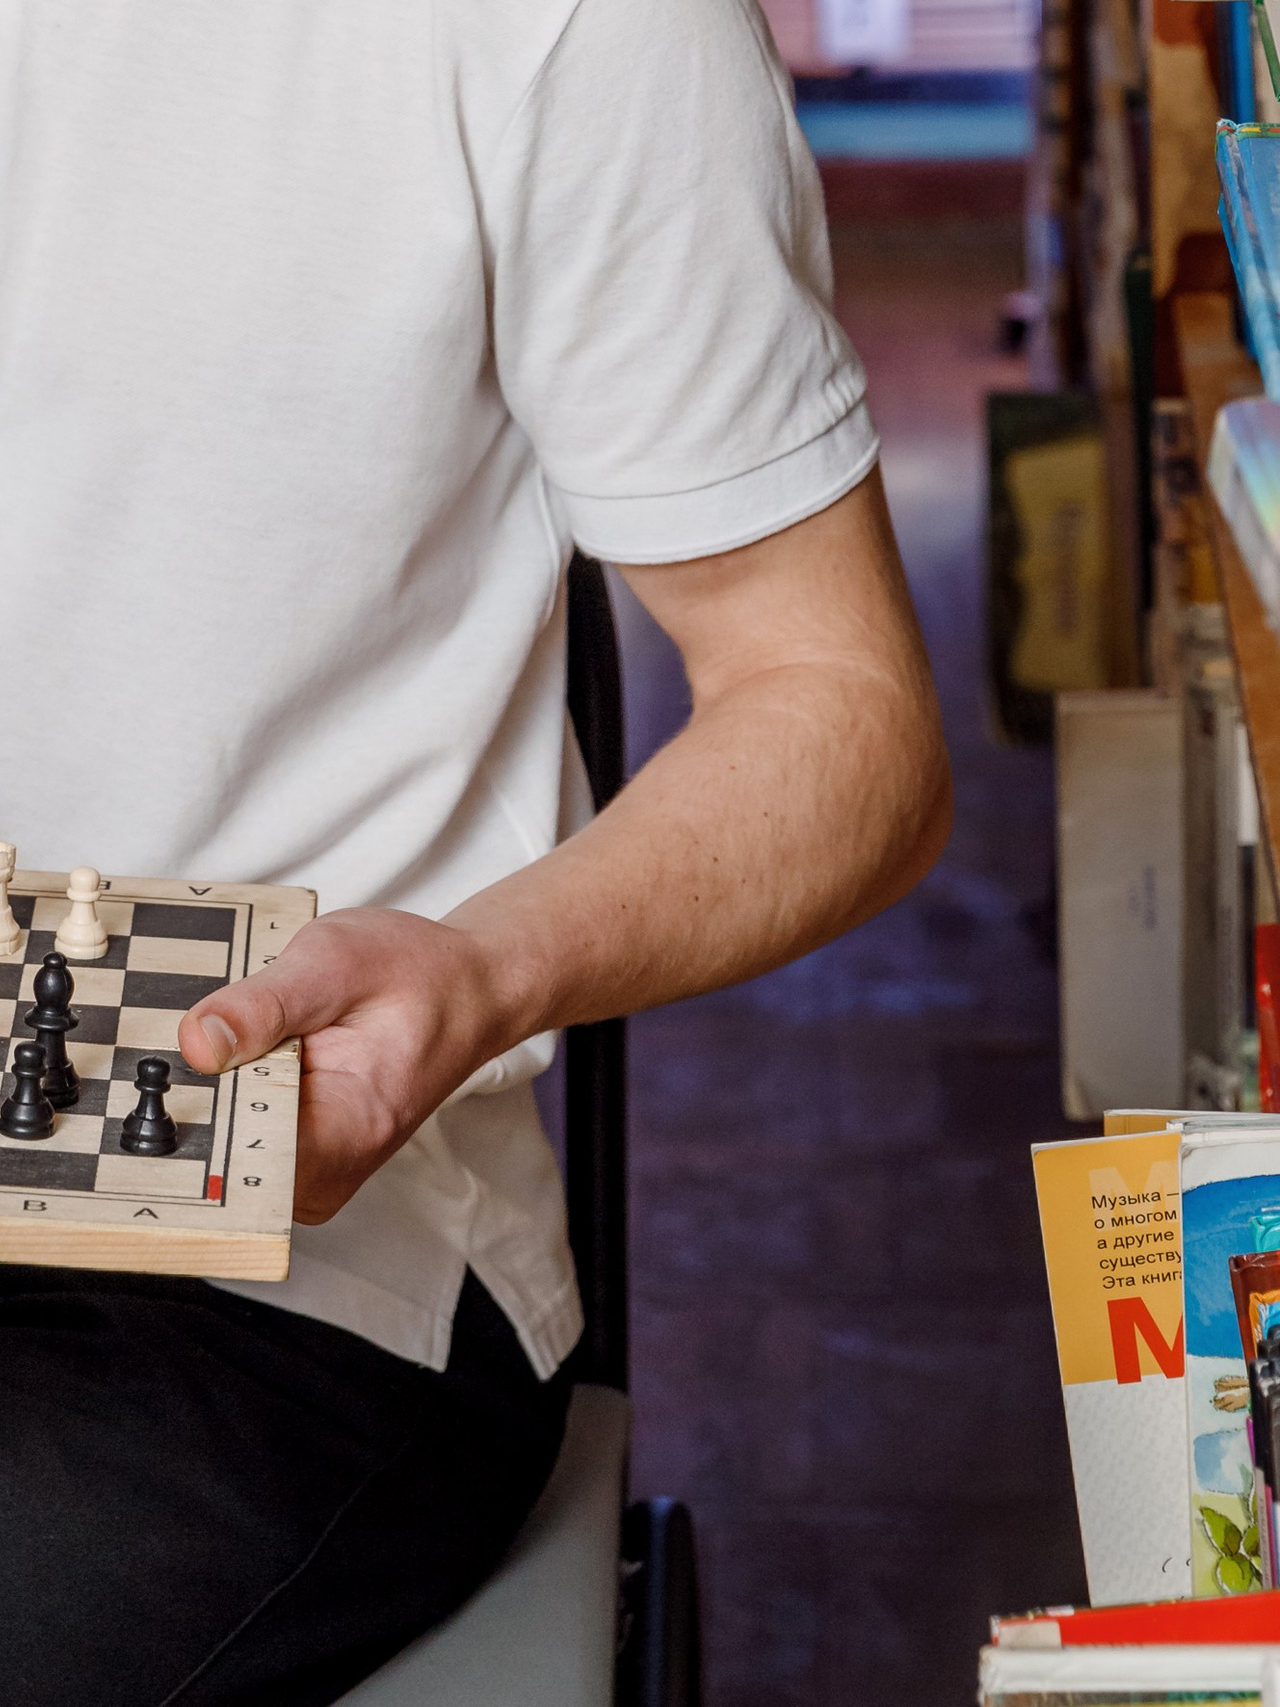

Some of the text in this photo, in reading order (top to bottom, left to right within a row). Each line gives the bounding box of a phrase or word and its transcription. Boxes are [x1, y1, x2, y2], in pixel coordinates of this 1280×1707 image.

[189, 886, 212, 896] A
[253, 1067, 270, 1077] 5
[246, 1139, 265, 1149] 7
[243, 1176, 262, 1187] 8
[23, 1200, 47, 1211] B
[1091, 1191, 1161, 1210] Музыка
[133, 1207, 160, 1219] A
[1094, 1210, 1177, 1229] о многом
[1097, 1231, 1175, 1250] а другие
[1102, 1275, 1136, 1289] Эта
